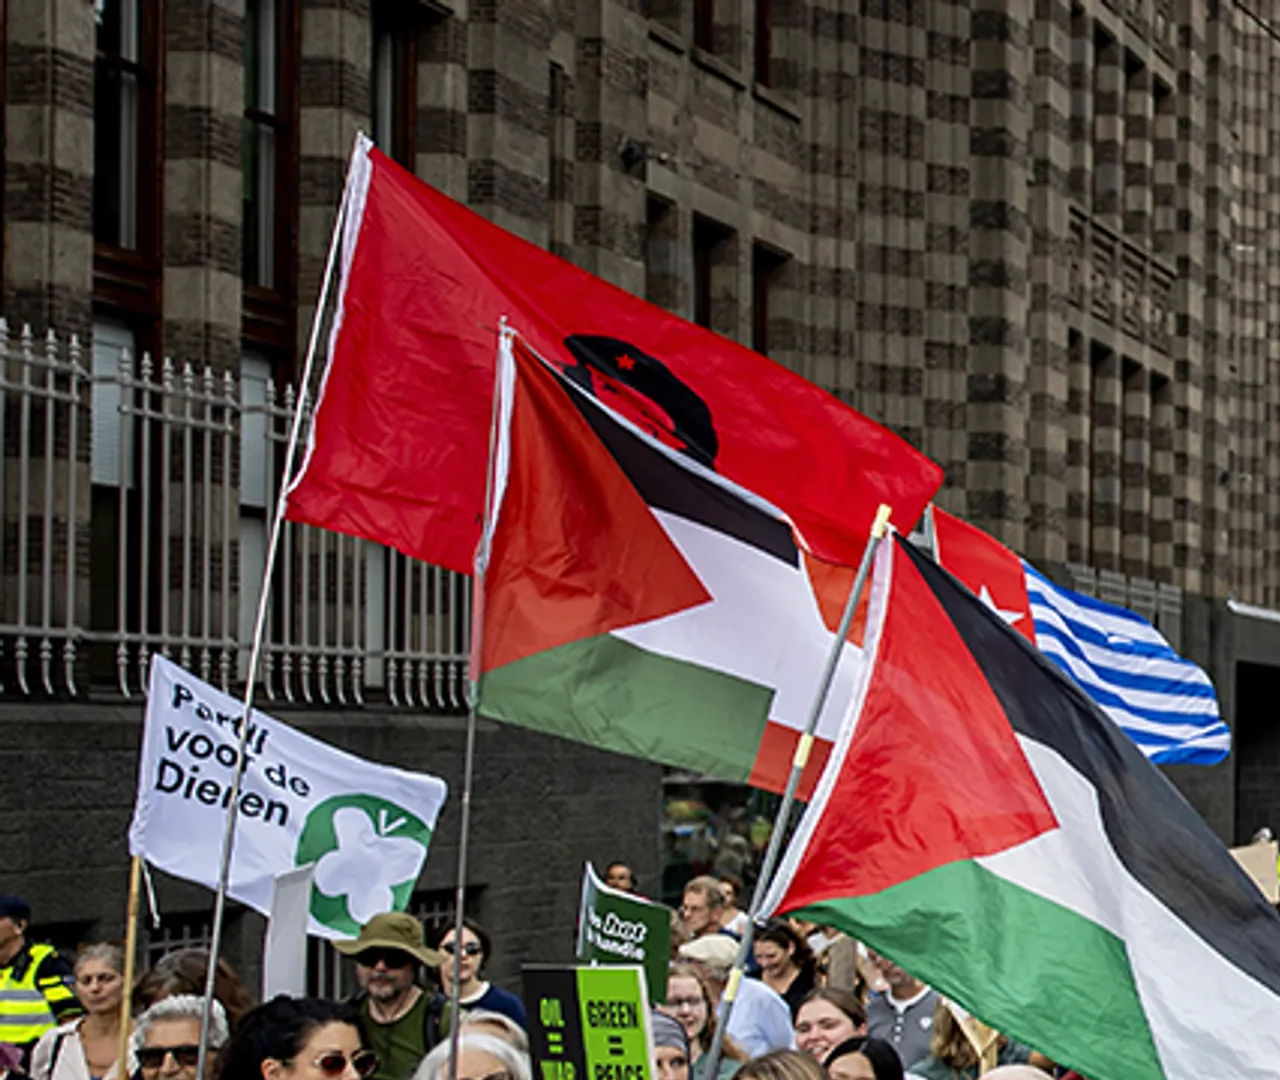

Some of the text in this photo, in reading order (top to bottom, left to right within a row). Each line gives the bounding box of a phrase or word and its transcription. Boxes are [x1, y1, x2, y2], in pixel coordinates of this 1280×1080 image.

[155, 757, 289, 826] Dieren
[165, 726, 311, 797] voor de
[587, 999, 638, 1028] GREEN
